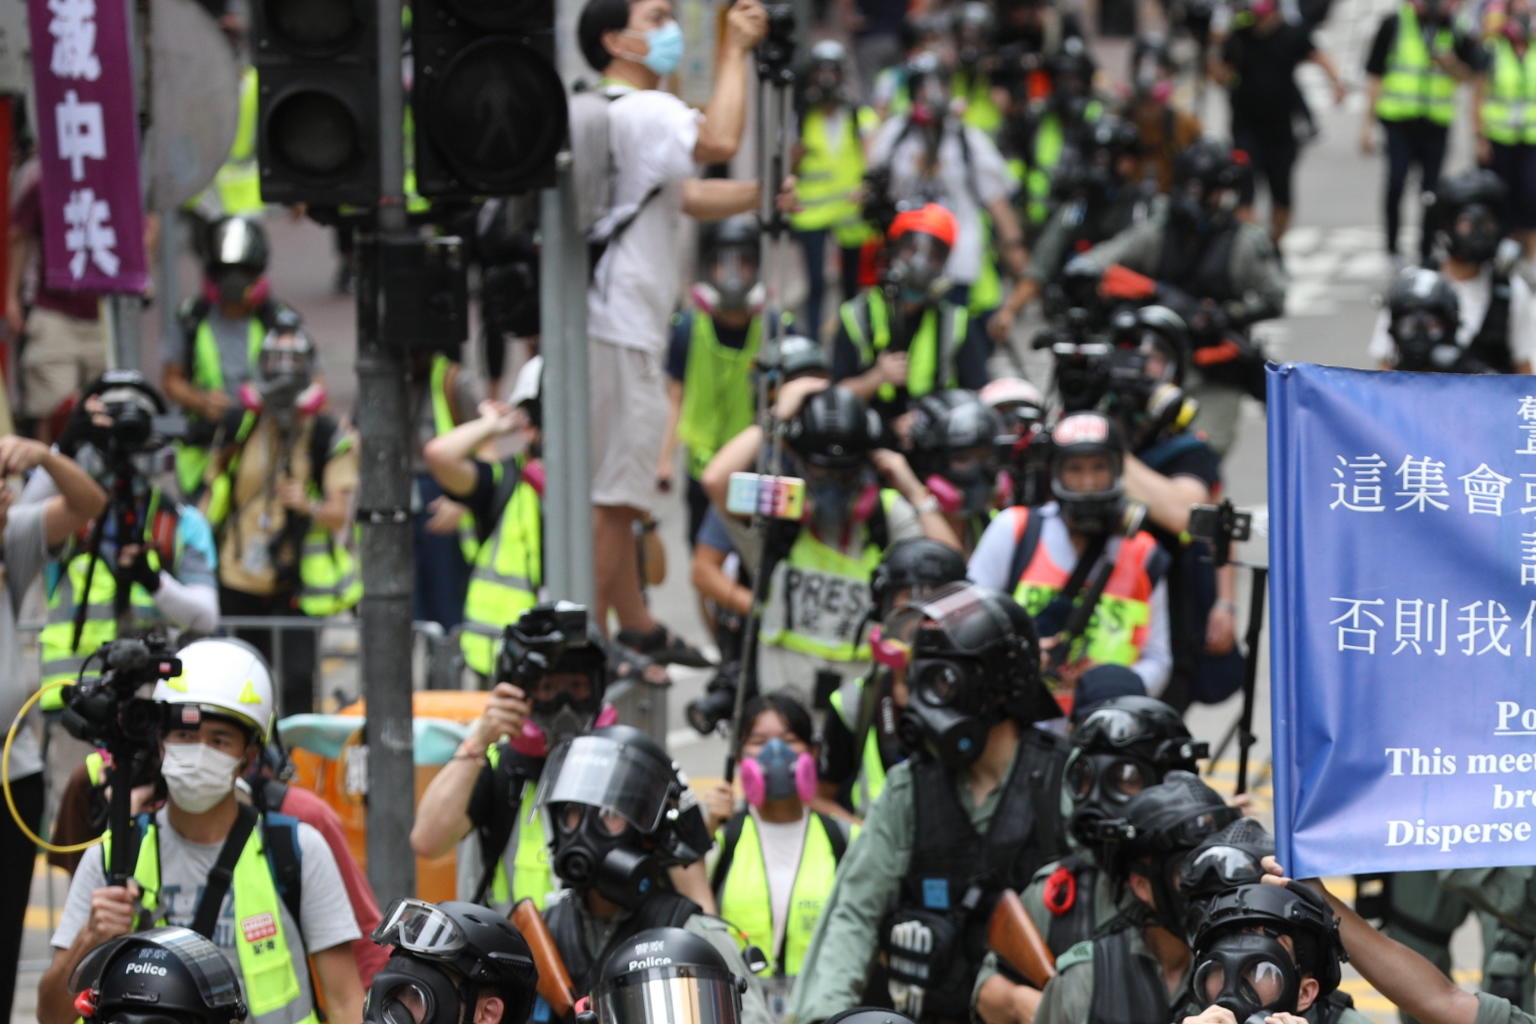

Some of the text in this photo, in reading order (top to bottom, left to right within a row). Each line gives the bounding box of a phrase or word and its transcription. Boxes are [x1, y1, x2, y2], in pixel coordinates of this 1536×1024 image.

[784, 570, 866, 616] PRES
[1386, 746, 1457, 776] This
[1386, 819, 1532, 852] Disperse
[126, 963, 168, 977] Police
[629, 956, 672, 971] Police
